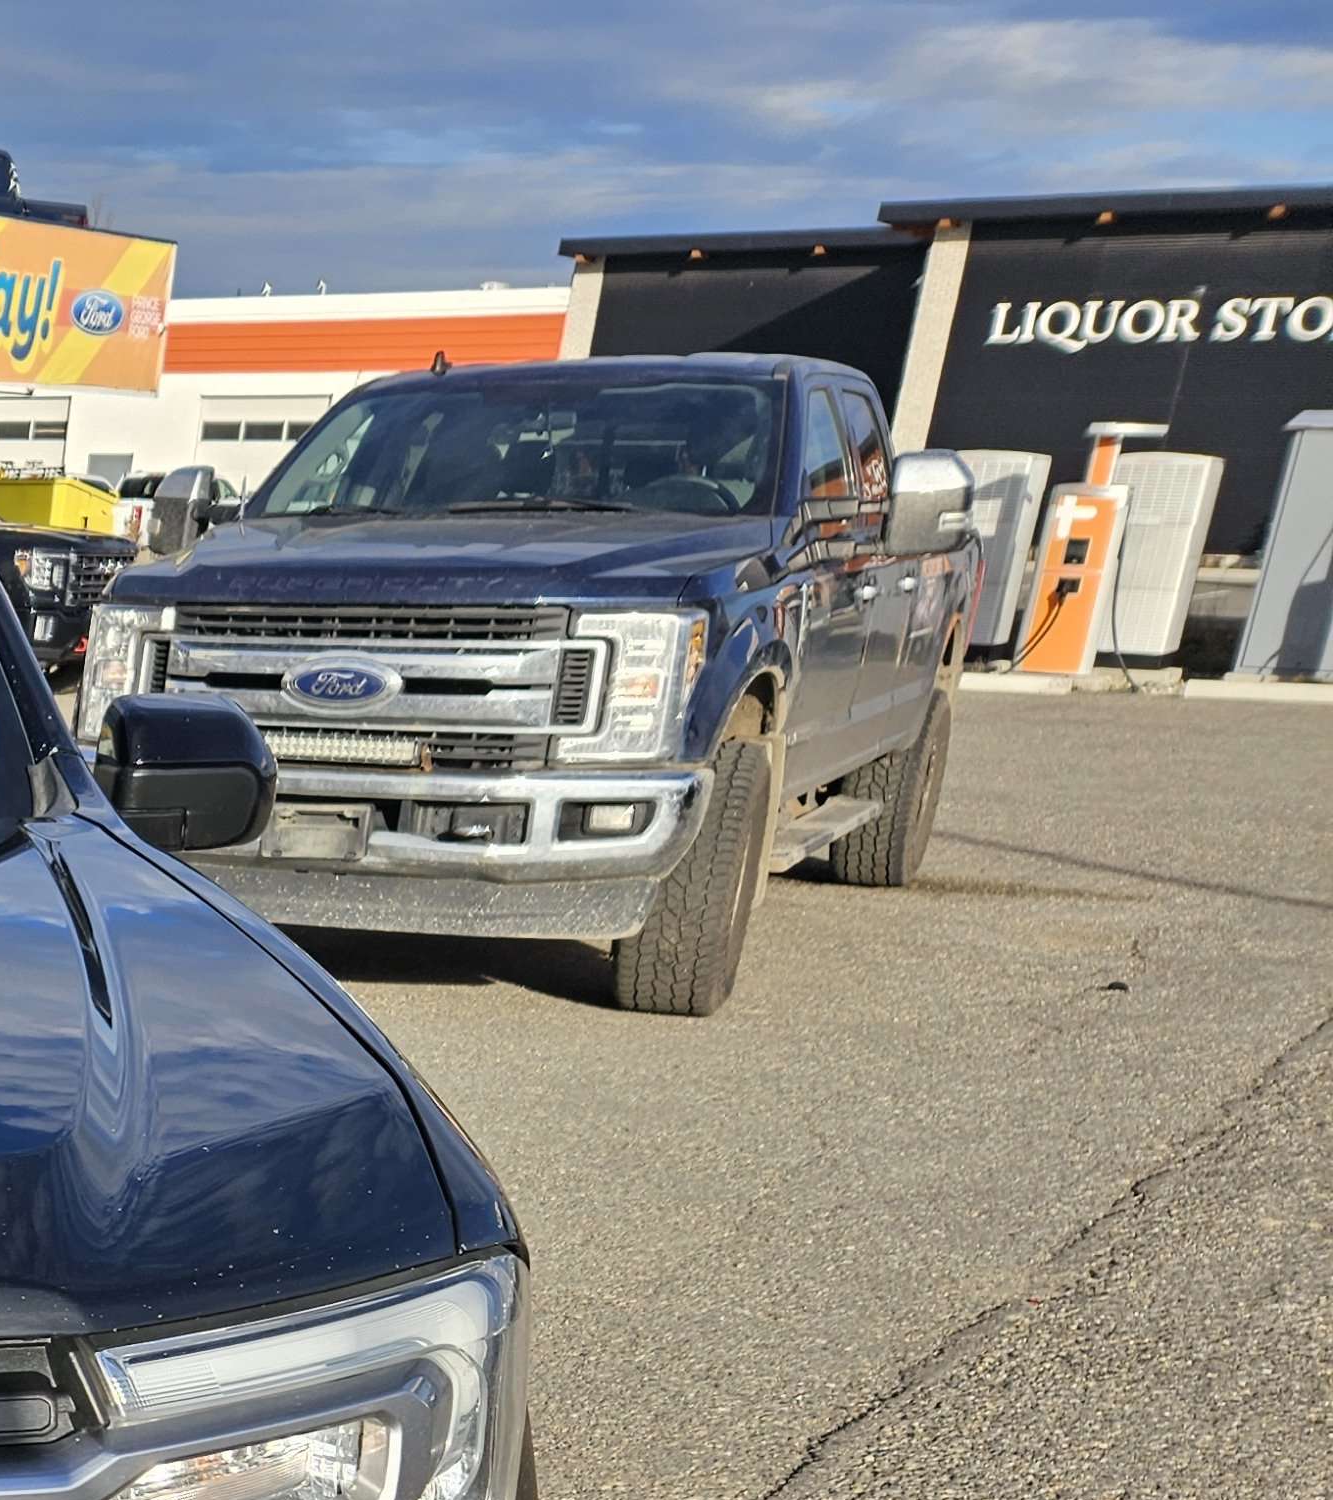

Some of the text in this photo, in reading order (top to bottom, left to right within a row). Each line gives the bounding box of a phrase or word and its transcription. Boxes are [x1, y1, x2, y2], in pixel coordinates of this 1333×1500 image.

[79, 294, 117, 329] Ford
[983, 296, 1333, 354] LIQUOR STO
[311, 671, 368, 696] Ford
